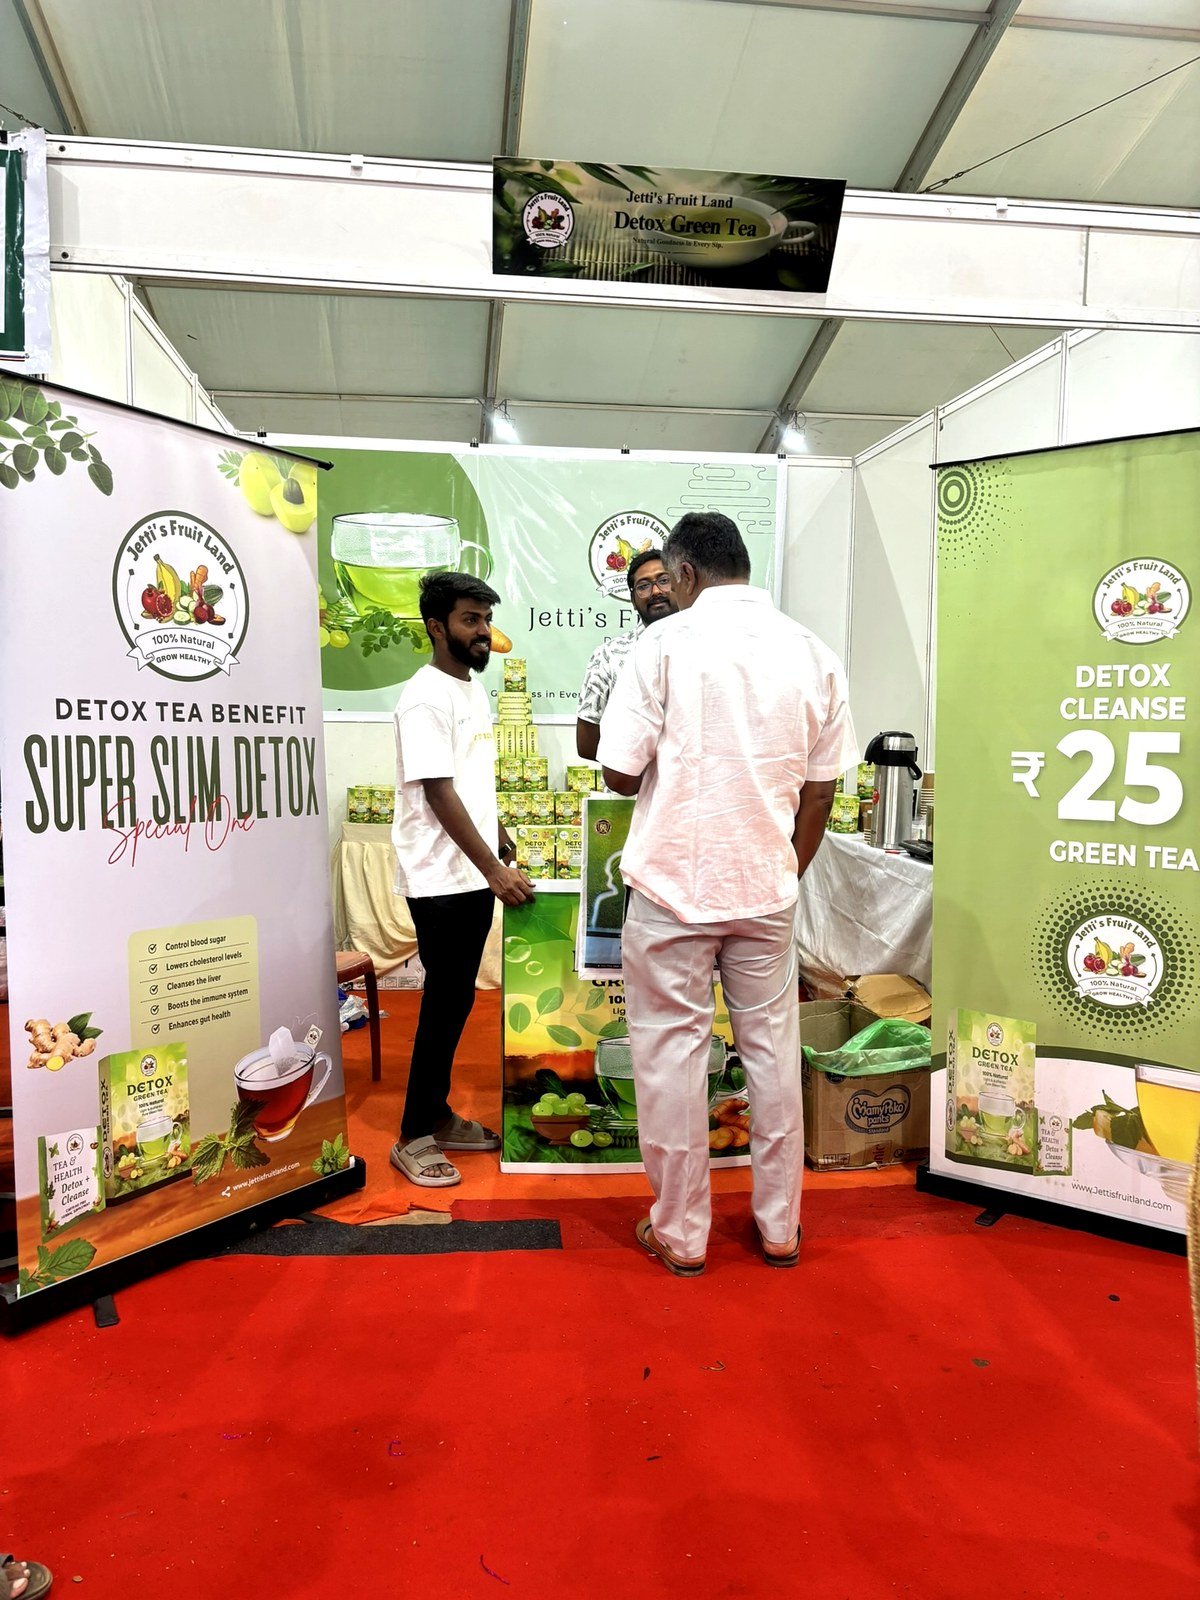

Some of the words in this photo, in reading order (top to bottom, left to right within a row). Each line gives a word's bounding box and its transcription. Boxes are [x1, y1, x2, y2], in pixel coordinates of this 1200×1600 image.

[544, 194, 559, 202] Fruit
[626, 191, 662, 204] Jetti's
[666, 193, 698, 206] Fruit
[701, 195, 733, 208] Land
[614, 211, 666, 231] Detox
[670, 215, 720, 234] Green
[725, 218, 757, 237] Tea
[633, 236, 656, 245] Natural
[693, 241, 711, 249] Every
[599, 518, 626, 542] Jetti's
[626, 515, 651, 527] Fruit
[126, 523, 168, 562] Jetti's
[169, 520, 204, 544] Fruit
[203, 535, 235, 575] Land
[1103, 566, 1132, 589] Jetti's
[1133, 562, 1158, 572] Fruit
[1158, 565, 1182, 585] Land
[1117, 621, 1136, 629] 100%
[152, 633, 179, 645] 100%
[180, 634, 215, 650] Natural
[156, 653, 178, 664] GROW
[179, 653, 212, 666] HEALTHY
[1075, 663, 1172, 688] DETOX
[545, 690, 555, 698] in
[559, 690, 580, 699] Eve
[56, 697, 148, 722] DETOX
[155, 701, 204, 723] TEA
[211, 703, 306, 724] BENEFIT
[1059, 696, 1186, 721] CLEANSE
[23, 734, 137, 834] SUPER
[150, 735, 222, 826] SLIM
[233, 736, 320, 820] DETOX
[1055, 729, 1184, 826] 25
[103, 795, 198, 867] Special
[205, 794, 256, 851] One
[1049, 840, 1136, 867] GREEN
[1144, 845, 1200, 872] TEA
[1075, 920, 1105, 941] Jetti's
[1106, 917, 1133, 931] Fruit
[1133, 925, 1156, 949] Land
[166, 940, 190, 951] Control
[190, 937, 208, 947] blood
[209, 936, 227, 945] sugar
[166, 960, 189, 971] Lowers
[189, 953, 225, 967] cholesterol
[225, 951, 242, 961] levels
[167, 980, 195, 991] Cleanses
[196, 976, 207, 985] the
[208, 974, 221, 983] liver
[1109, 981, 1137, 992] Natural
[168, 1000, 189, 1011] Boosts
[190, 998, 201, 1006] the
[201, 993, 227, 1004] immune
[227, 988, 249, 1000] system
[608, 995, 626, 1005] 10
[168, 1018, 199, 1031] Enhances
[199, 1015, 211, 1026] gut
[211, 1010, 232, 1020] health
[612, 1007, 626, 1016] Lig
[972, 1046, 1019, 1067] DETOX
[977, 1060, 1000, 1071] GREEN
[1000, 1065, 1013, 1073] TEA
[126, 1075, 173, 1096] DETOX
[133, 1091, 155, 1102] GREEN
[156, 1088, 169, 1096] TEA
[867, 1115, 891, 1127] pants
[53, 1160, 68, 1172] TEA
[53, 1166, 83, 1183] HEALTH
[61, 1179, 83, 1194] Detox
[61, 1188, 90, 1206] Cleanse
[1071, 1182, 1172, 1212] www.Jettisfruitland.com
